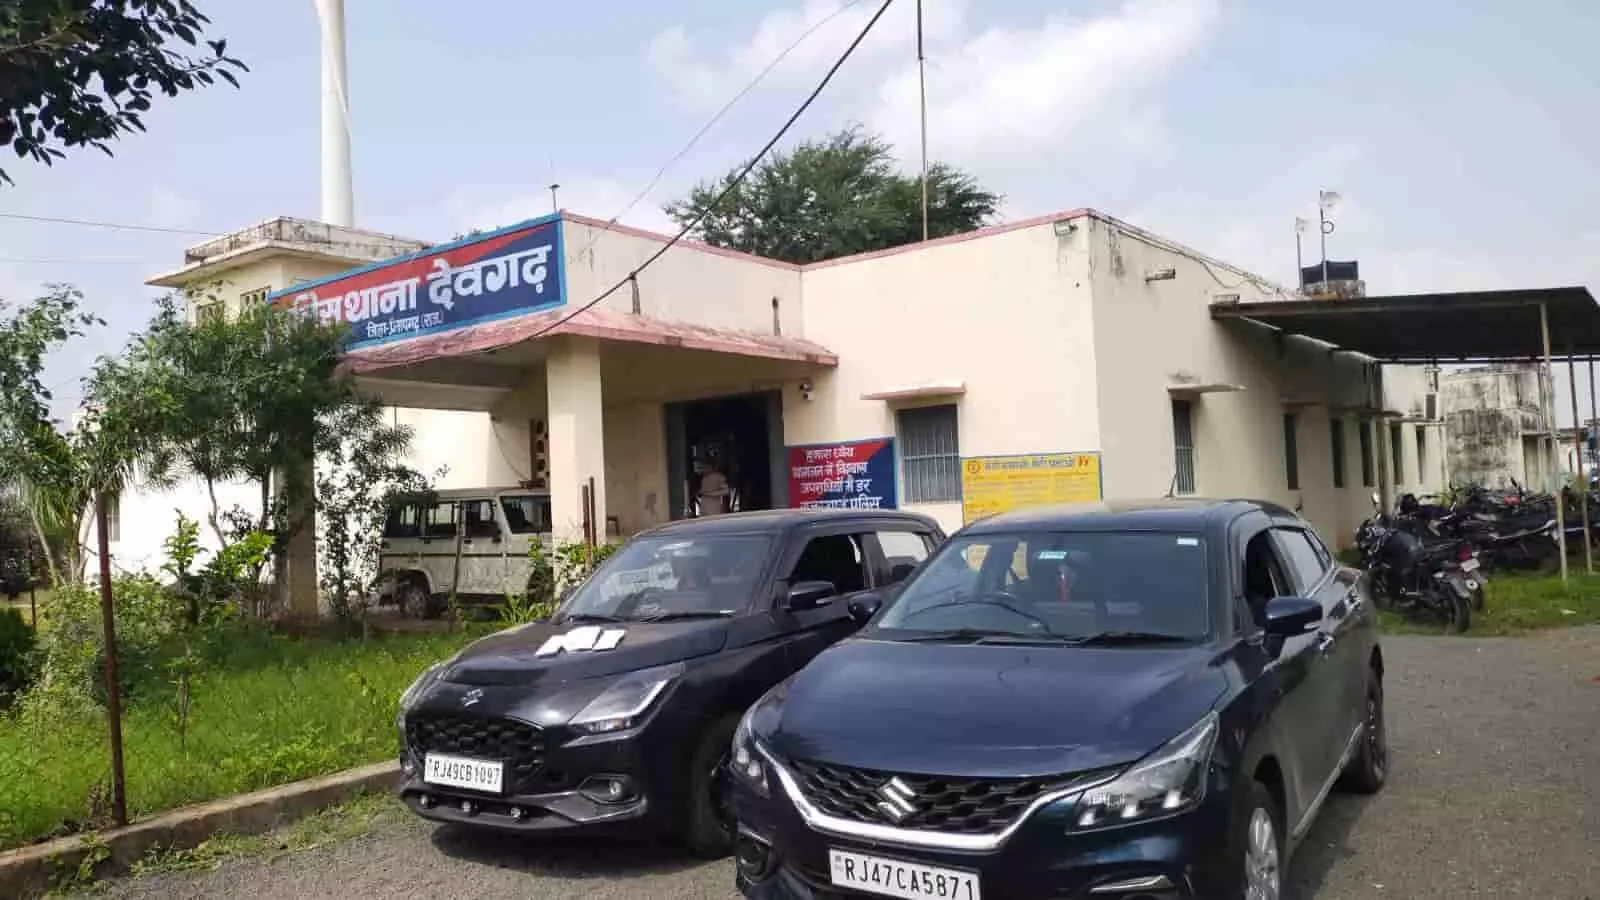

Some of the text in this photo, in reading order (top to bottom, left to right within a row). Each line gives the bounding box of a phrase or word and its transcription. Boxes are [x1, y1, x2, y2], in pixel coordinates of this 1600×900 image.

[426, 244, 553, 311] देवगढ़
[855, 479, 873, 493] डर
[844, 856, 973, 900] RJ47CA5871
